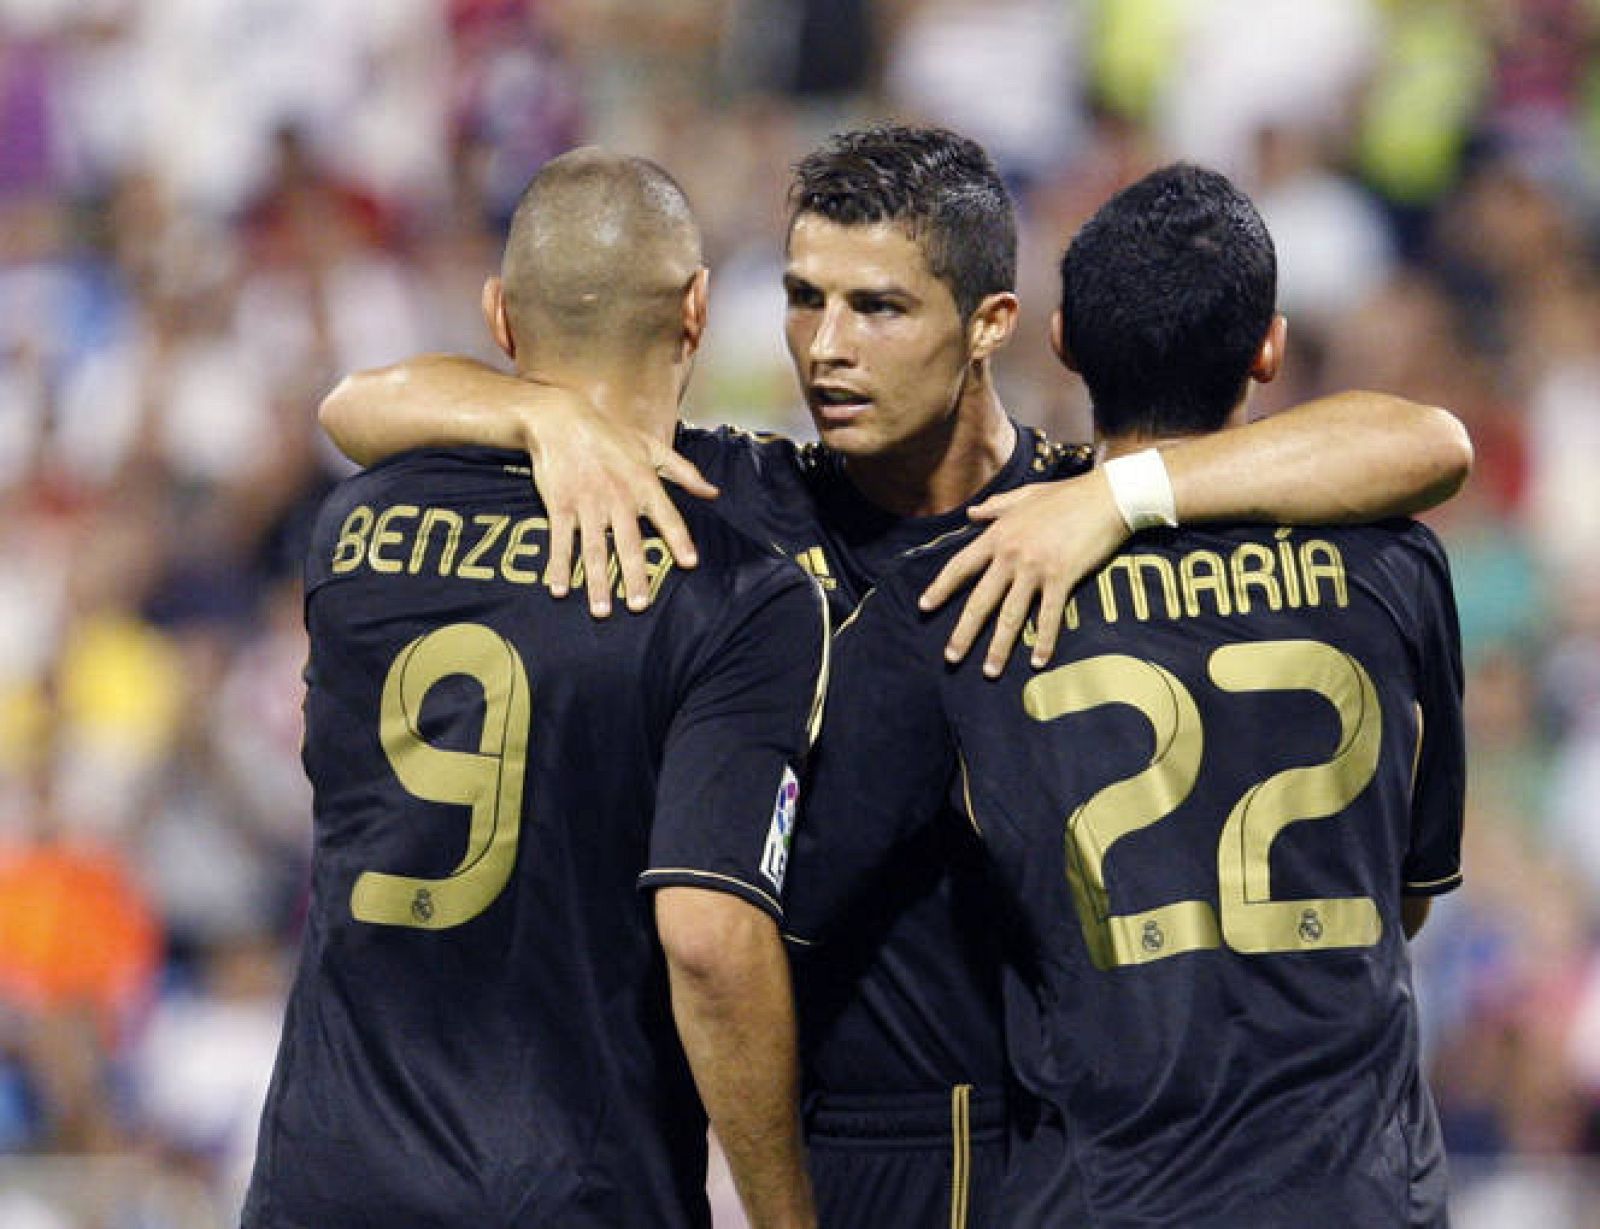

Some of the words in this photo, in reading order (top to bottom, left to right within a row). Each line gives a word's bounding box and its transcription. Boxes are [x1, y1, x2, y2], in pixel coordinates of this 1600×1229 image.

[1098, 527, 1348, 624] MARÍA
[350, 622, 531, 930] 9
[1023, 640, 1383, 971] 22
